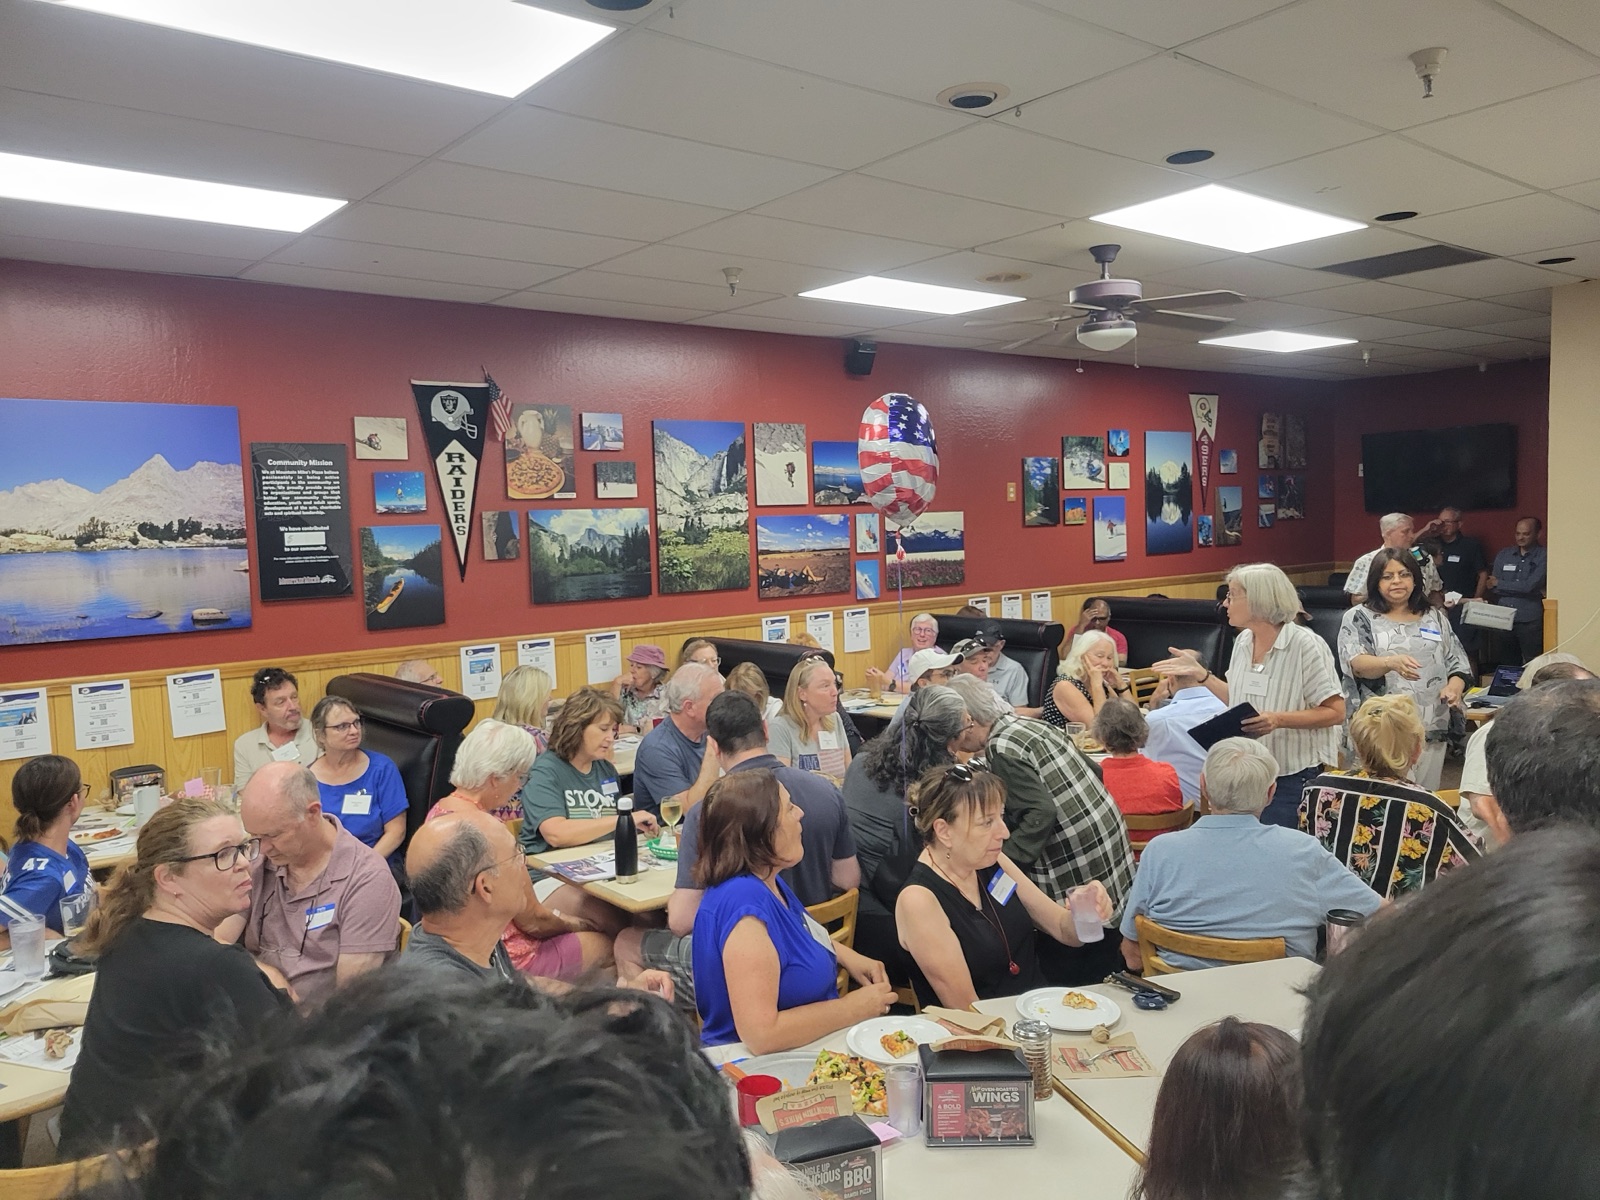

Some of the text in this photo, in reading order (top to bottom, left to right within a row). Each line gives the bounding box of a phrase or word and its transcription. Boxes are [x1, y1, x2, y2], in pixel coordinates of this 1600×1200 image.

[445, 452, 466, 536] RAIDERS
[22, 858, 49, 871] 47
[972, 1092, 1020, 1103] WINGS
[821, 1162, 830, 1172] UP
[844, 1165, 872, 1188] BBQ
